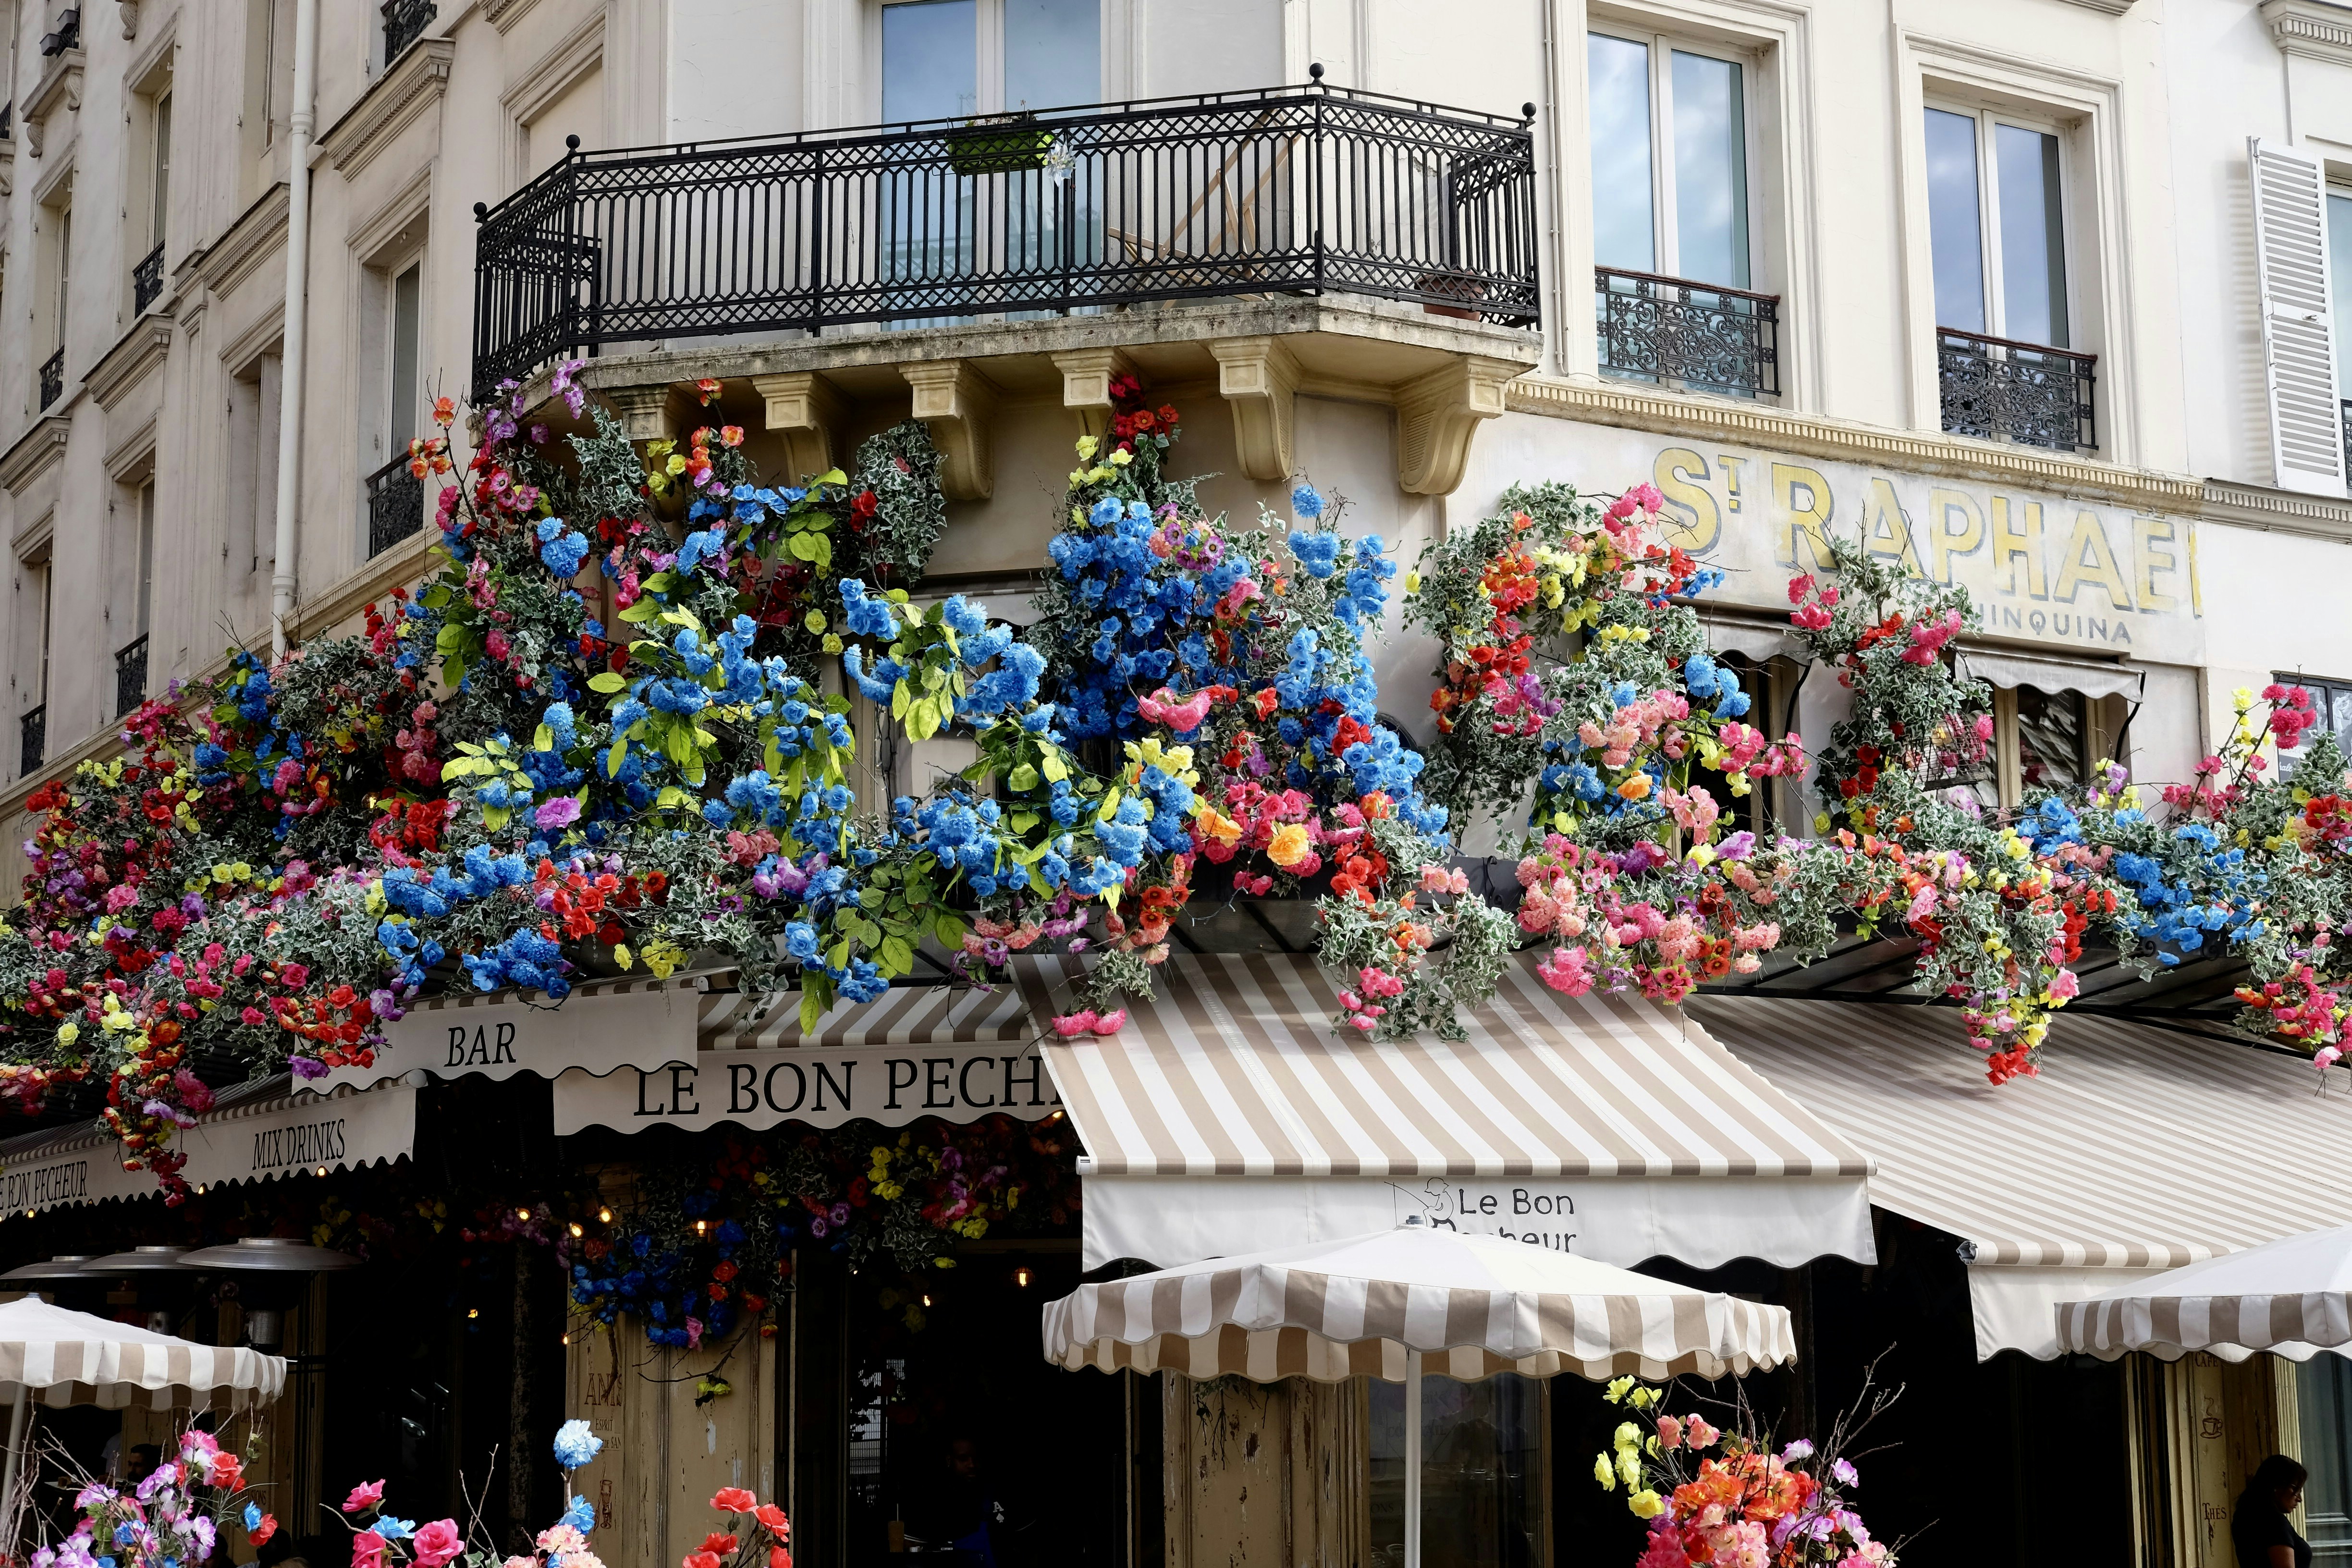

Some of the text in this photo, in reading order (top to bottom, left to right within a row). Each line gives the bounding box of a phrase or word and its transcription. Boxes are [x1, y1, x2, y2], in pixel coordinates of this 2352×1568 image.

[443, 1022, 516, 1067] BAR
[634, 1055, 1064, 1116] LE BON PECH
[252, 1118, 345, 1171] MIX DRINKS
[8, 1171, 31, 1209] BON
[34, 1160, 87, 1204] PECHEUR
[1458, 1188, 1575, 1215] Le Bon
[595, 1418, 613, 1431] ESPRIT
